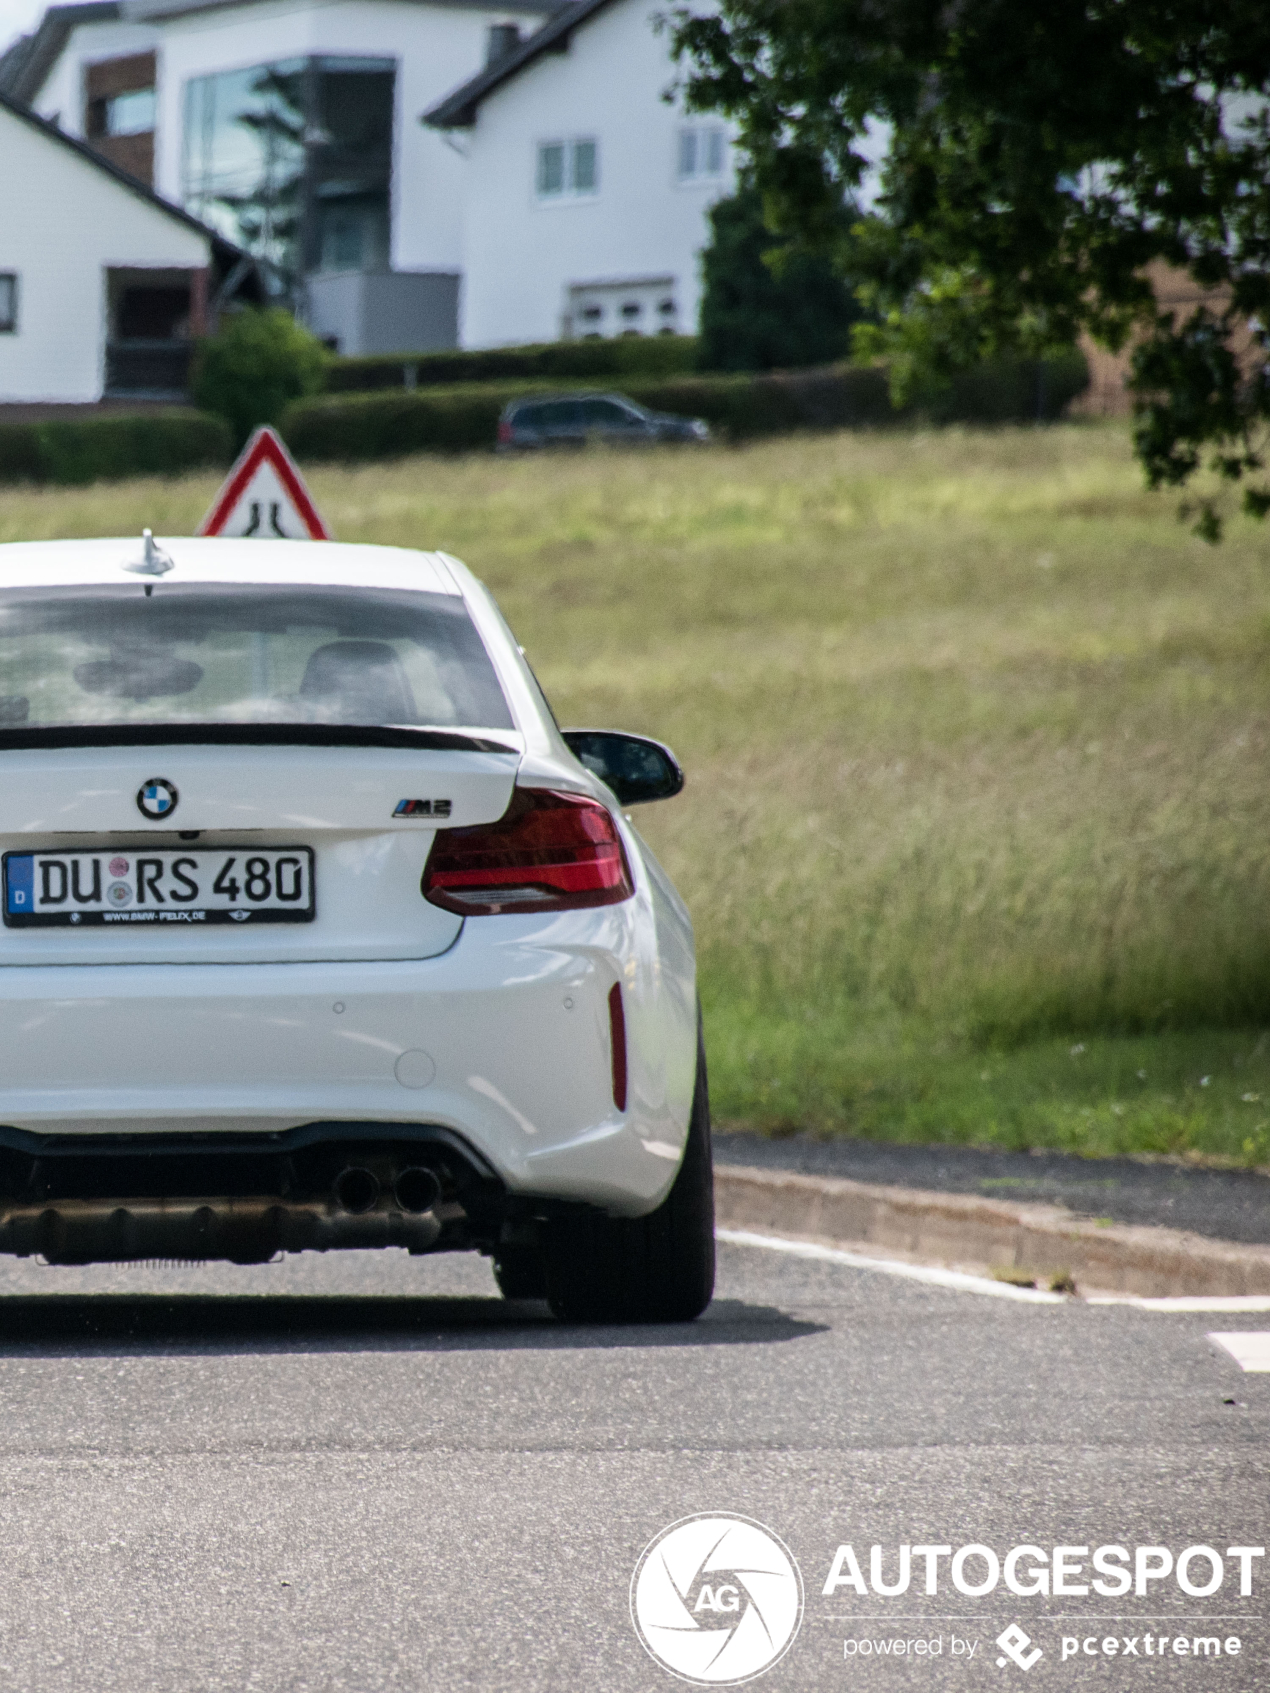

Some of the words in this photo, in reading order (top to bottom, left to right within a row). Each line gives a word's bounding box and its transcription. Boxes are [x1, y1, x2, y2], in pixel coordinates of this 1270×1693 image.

[39, 859, 101, 904] DU
[136, 858, 199, 904] RS
[212, 857, 302, 902] 480
[14, 890, 26, 904] D
